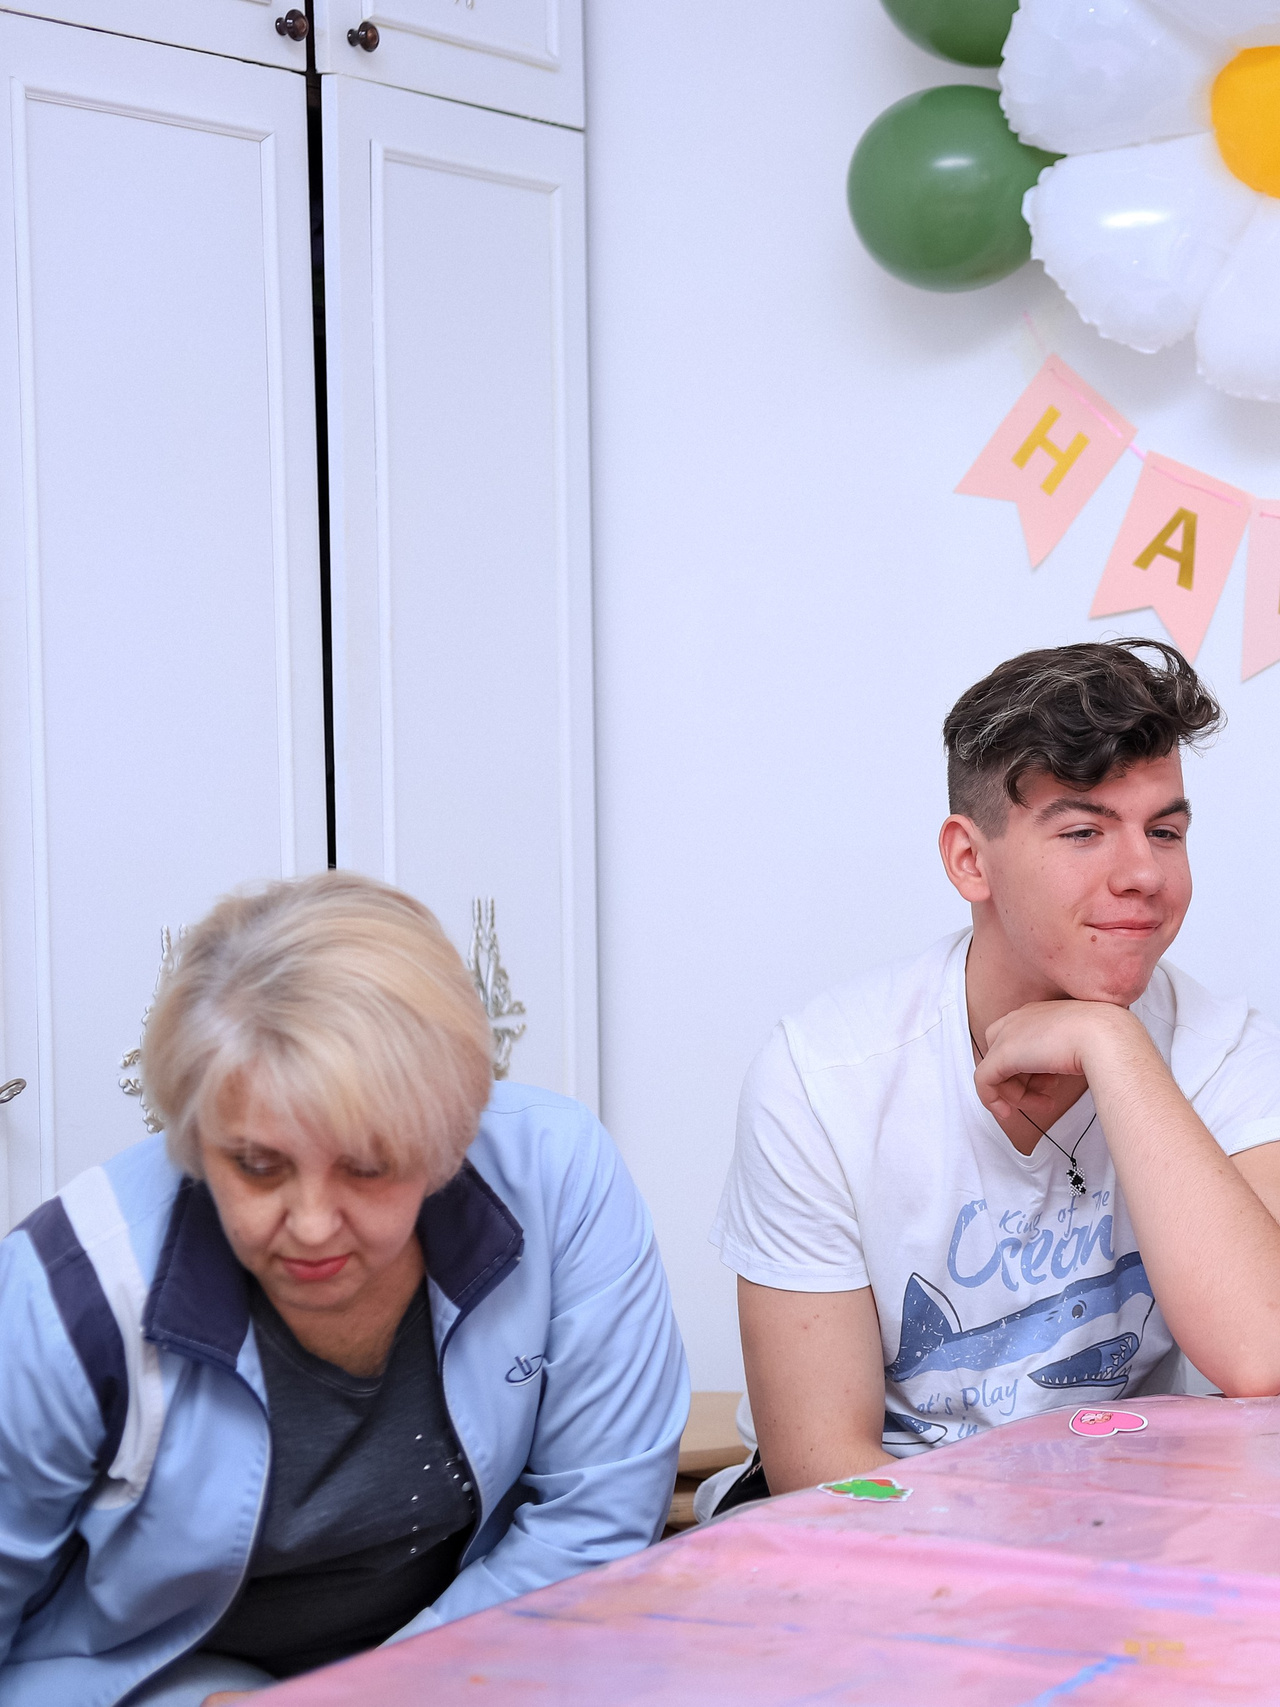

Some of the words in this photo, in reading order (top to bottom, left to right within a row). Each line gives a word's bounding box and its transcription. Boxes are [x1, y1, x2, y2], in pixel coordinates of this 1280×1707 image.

[946, 1198, 1115, 1292] Ocean
[998, 1209, 1043, 1240] King
[1057, 1194, 1078, 1239] of
